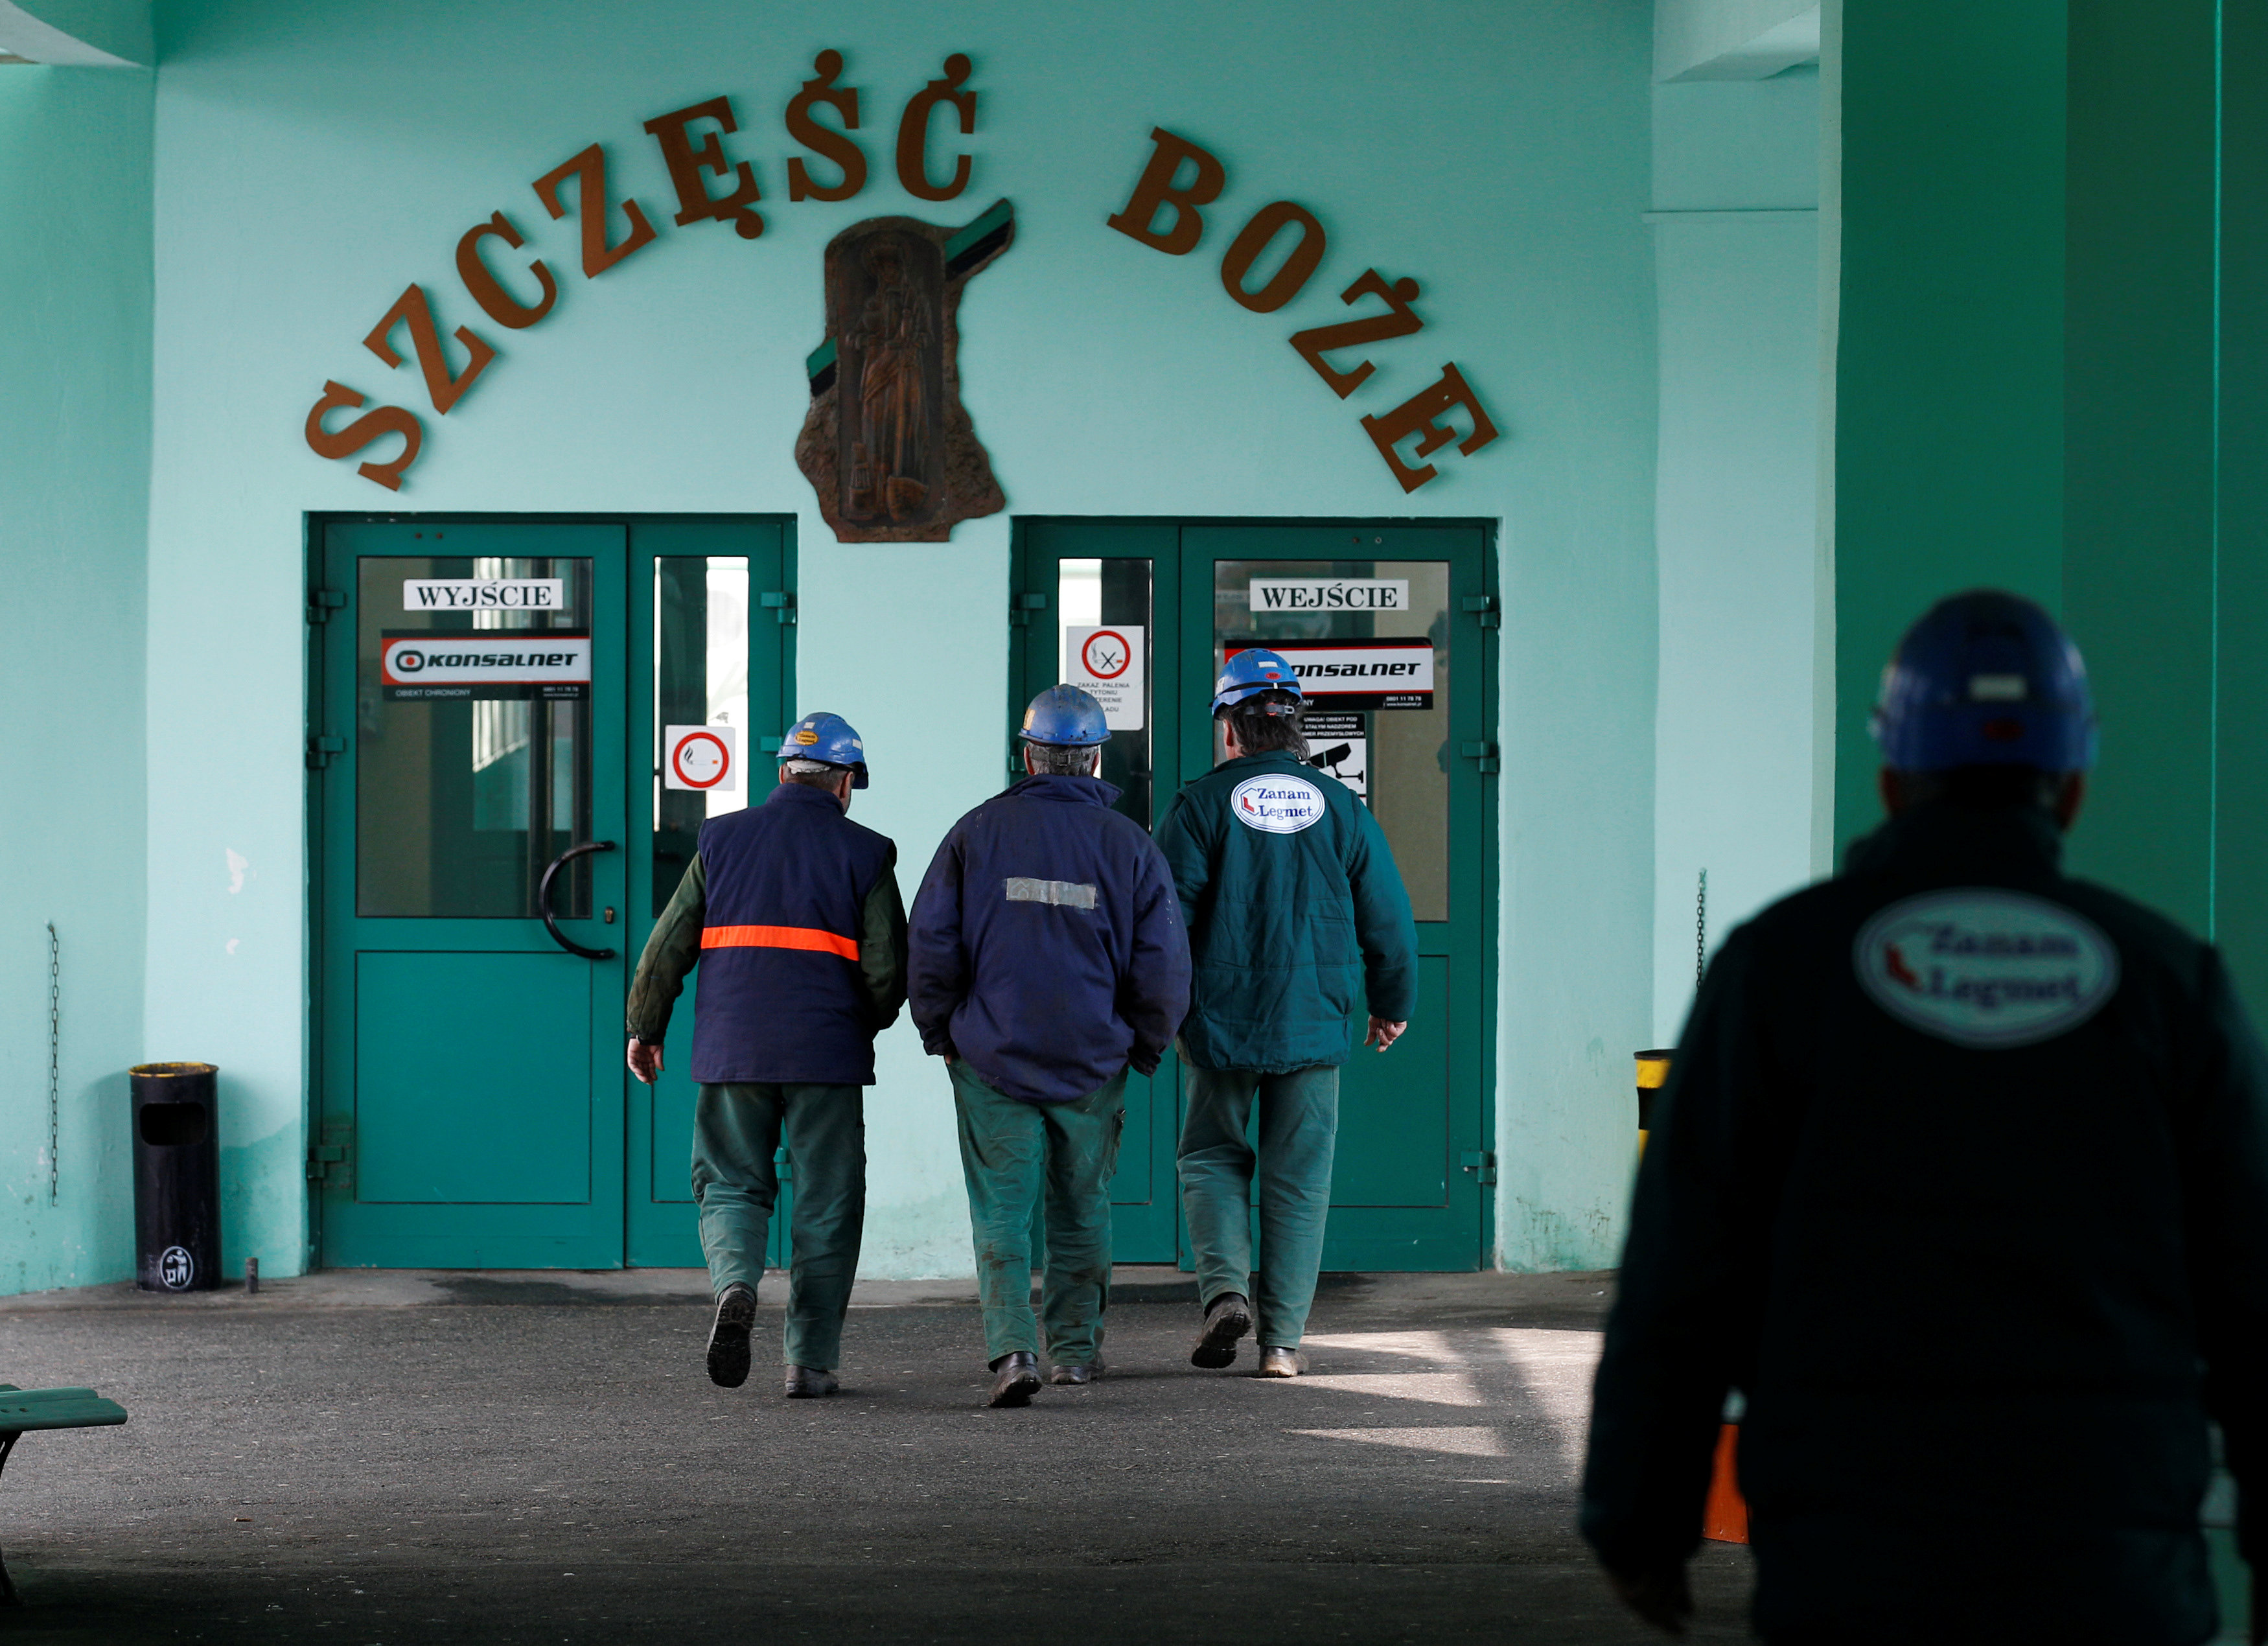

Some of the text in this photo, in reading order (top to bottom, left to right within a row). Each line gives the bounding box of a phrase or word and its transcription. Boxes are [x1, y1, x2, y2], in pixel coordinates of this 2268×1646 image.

[305, 49, 1499, 494] SZCZĘŚĆ BOŻE
[417, 582, 551, 607] WYJŚCIE
[1261, 583, 1398, 608] WEJŚCIE
[1257, 788, 1312, 800] Zanam
[1258, 806, 1313, 820] Legmet
